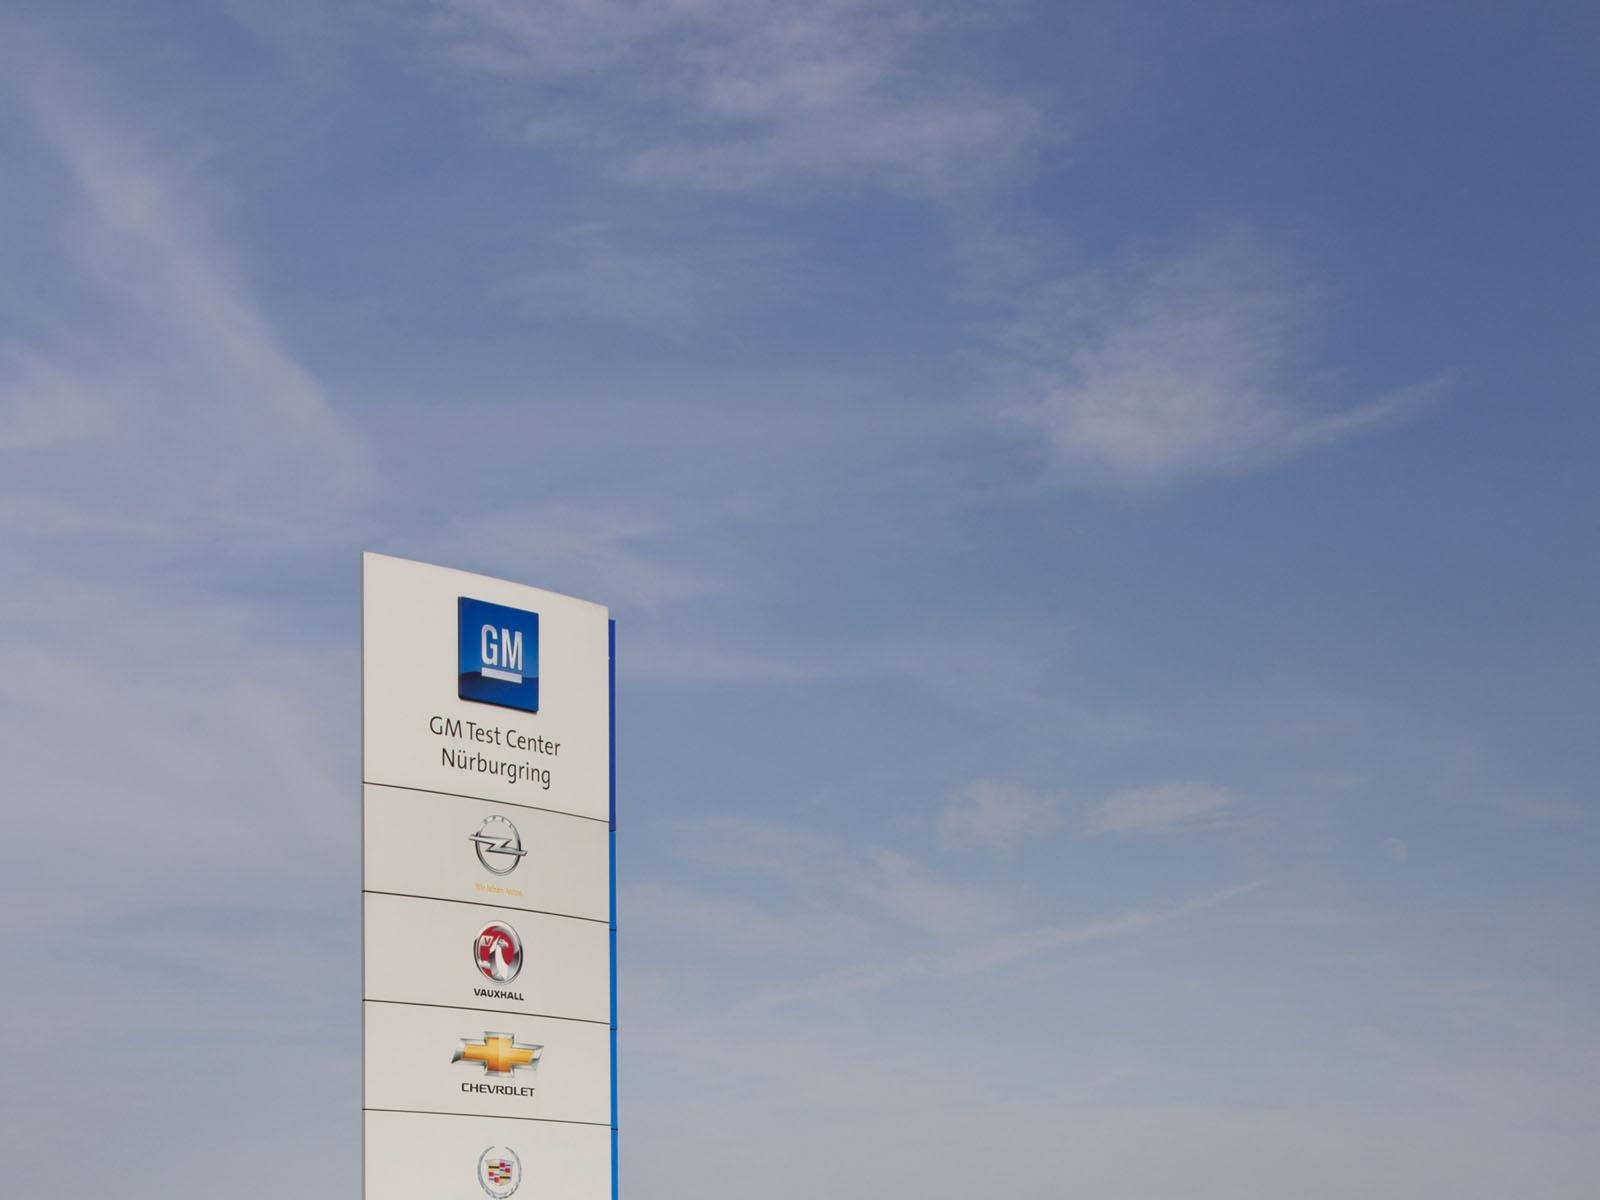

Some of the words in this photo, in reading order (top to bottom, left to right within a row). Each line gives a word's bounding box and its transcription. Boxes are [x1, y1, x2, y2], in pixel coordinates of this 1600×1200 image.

[481, 624, 523, 671] GM
[429, 716, 463, 738] GM
[466, 721, 501, 746] Test
[506, 729, 561, 757] Center
[442, 748, 551, 790] Nürburgring
[473, 988, 525, 1001] VAUXHALL
[461, 1083, 536, 1097] CHEVROLET
